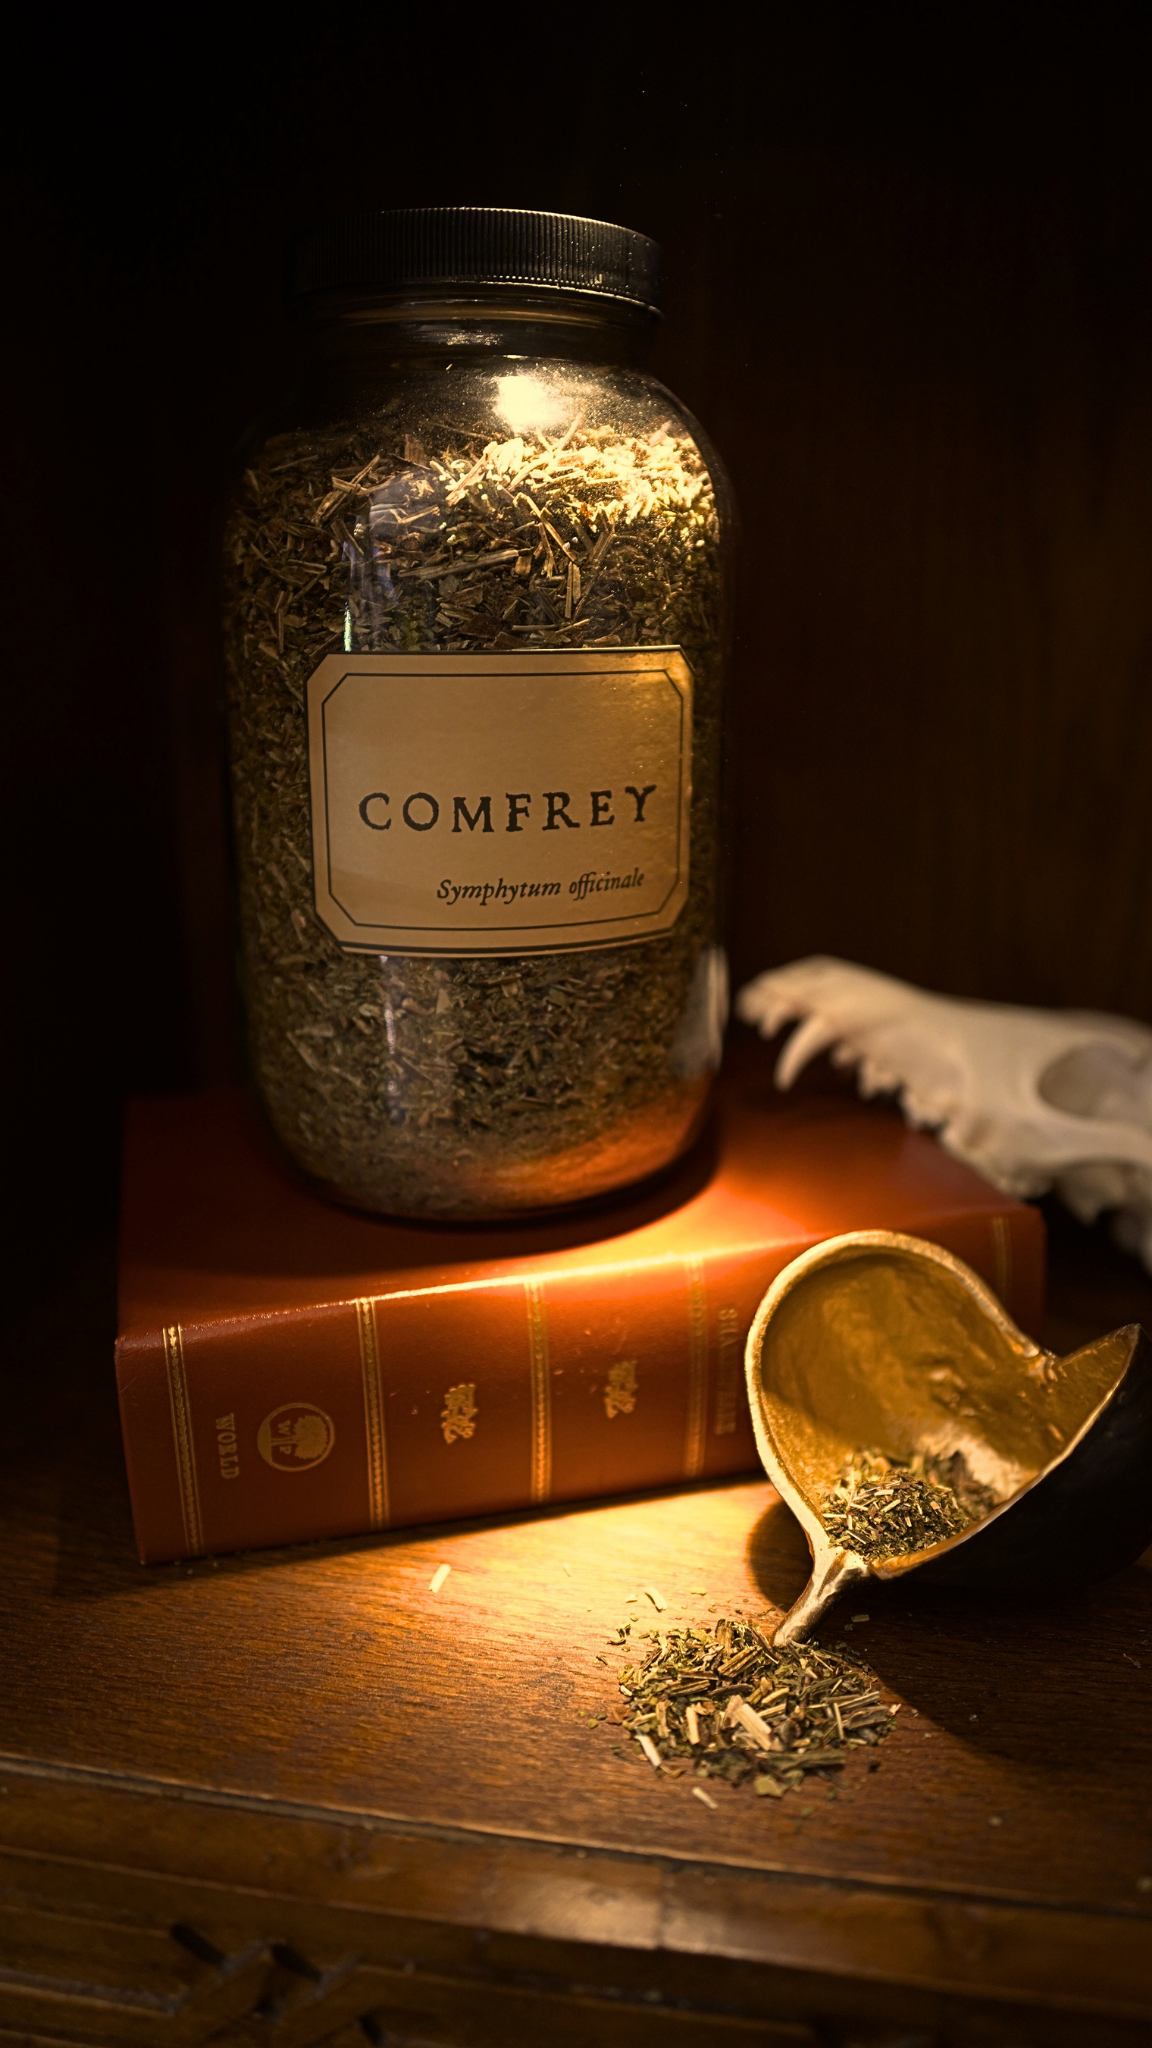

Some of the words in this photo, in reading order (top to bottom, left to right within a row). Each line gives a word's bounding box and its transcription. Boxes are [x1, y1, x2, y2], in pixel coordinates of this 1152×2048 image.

[359, 784, 657, 832] COMFREY
[437, 878, 561, 906] Symphytum
[569, 867, 645, 901] officinale
[215, 1412, 239, 1479] WORLD
